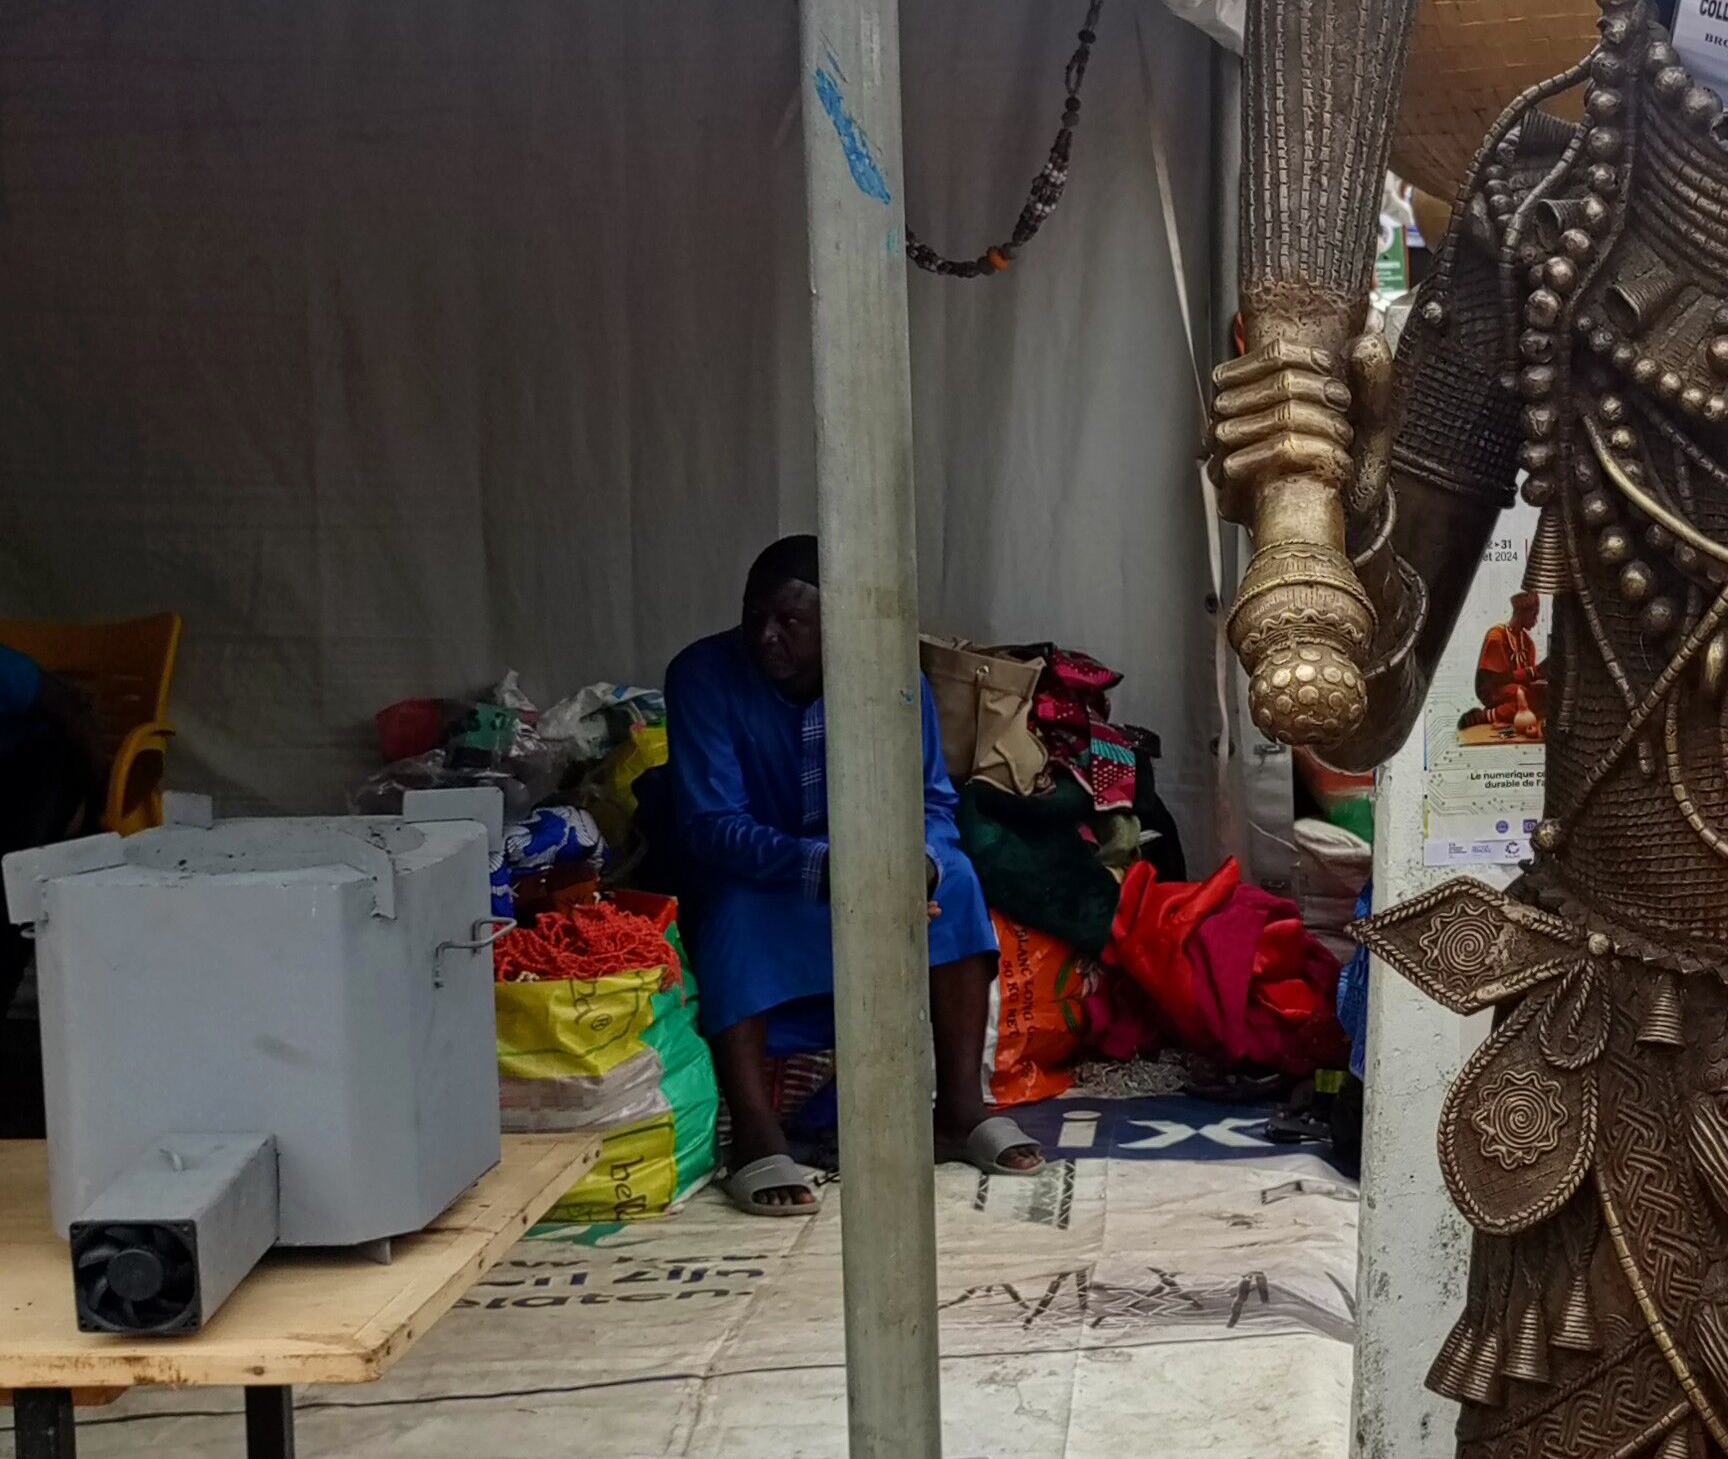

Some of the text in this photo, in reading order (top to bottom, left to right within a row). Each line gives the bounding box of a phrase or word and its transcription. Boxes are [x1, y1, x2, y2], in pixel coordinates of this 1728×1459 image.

[1495, 551, 1518, 562] 2024
[1470, 772, 1481, 781] Le
[1484, 779, 1520, 789] durable
[1522, 778, 1534, 788] de
